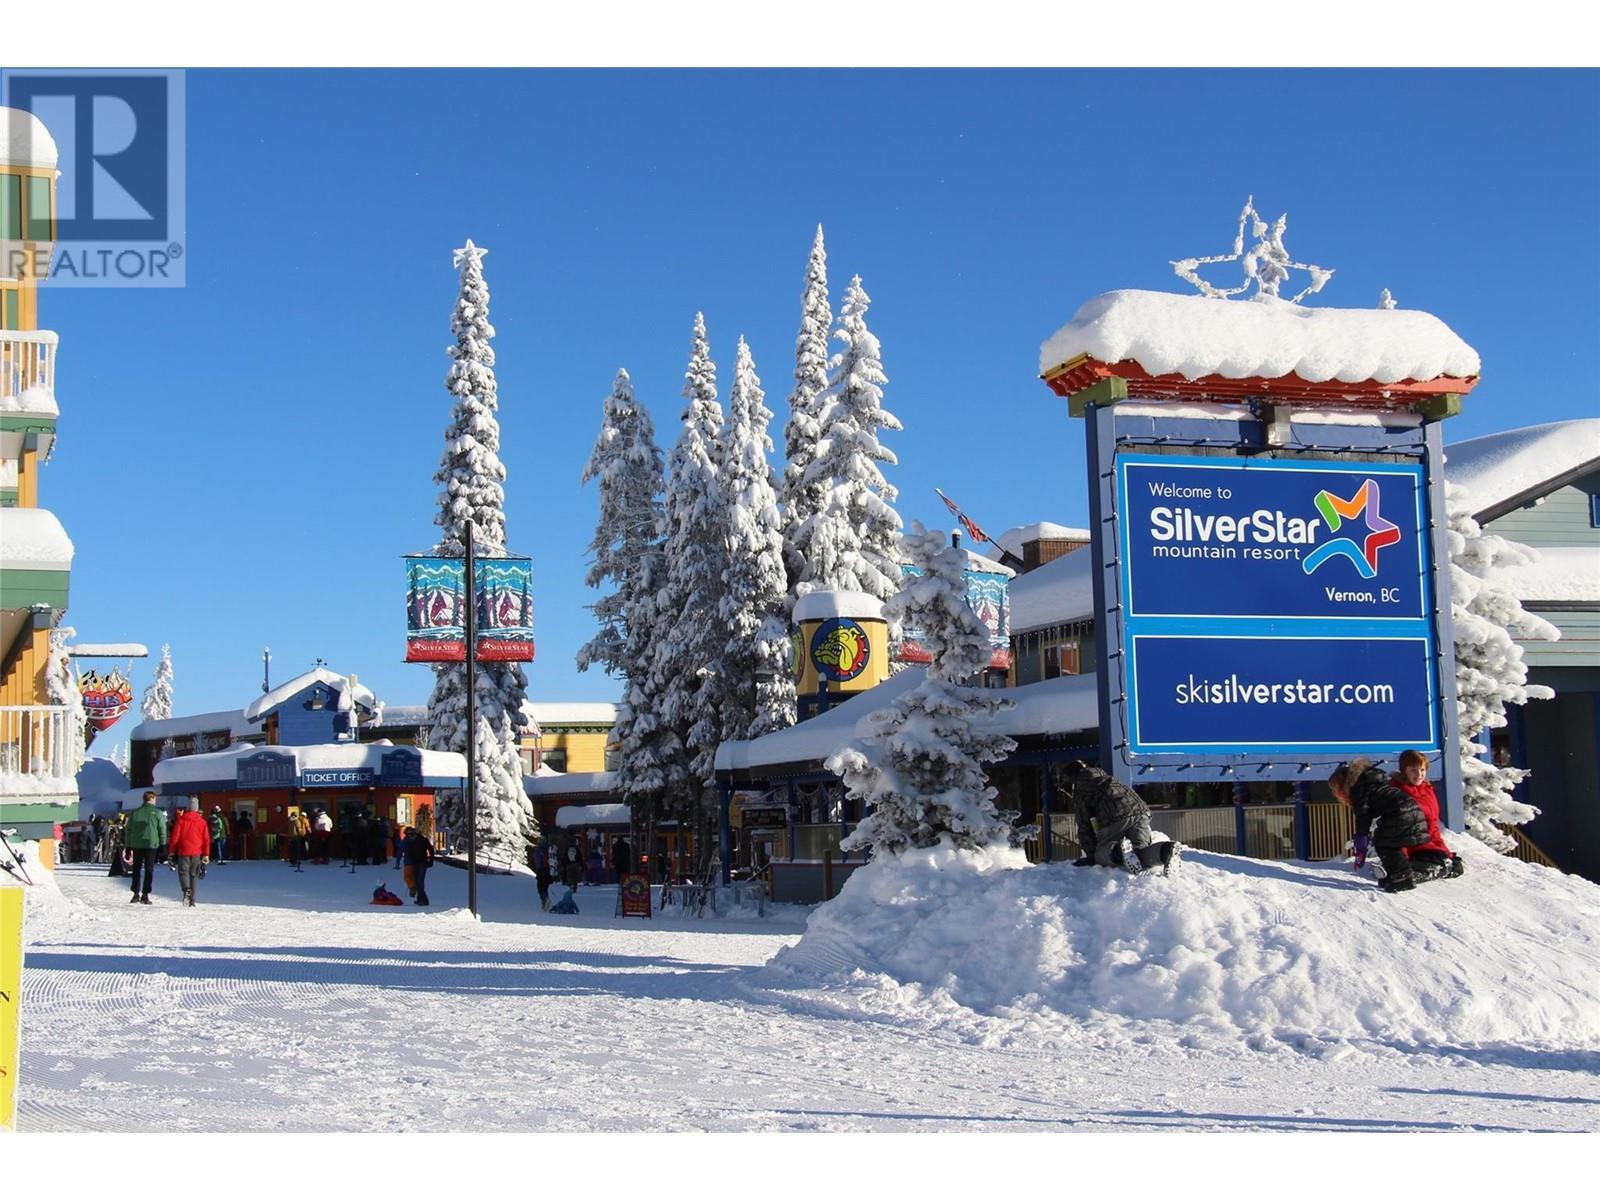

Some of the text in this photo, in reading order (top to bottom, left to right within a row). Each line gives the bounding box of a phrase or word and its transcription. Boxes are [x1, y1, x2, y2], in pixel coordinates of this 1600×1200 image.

[1148, 481, 1232, 500] Welcome to
[1150, 506, 1320, 544] SilverStar
[1153, 544, 1301, 561] mountain resort
[1325, 586, 1400, 604] Vernon, BC
[1175, 673, 1394, 704] skisilverstar.com
[305, 772, 337, 783] TICKET
[339, 772, 372, 783] OFFICE
